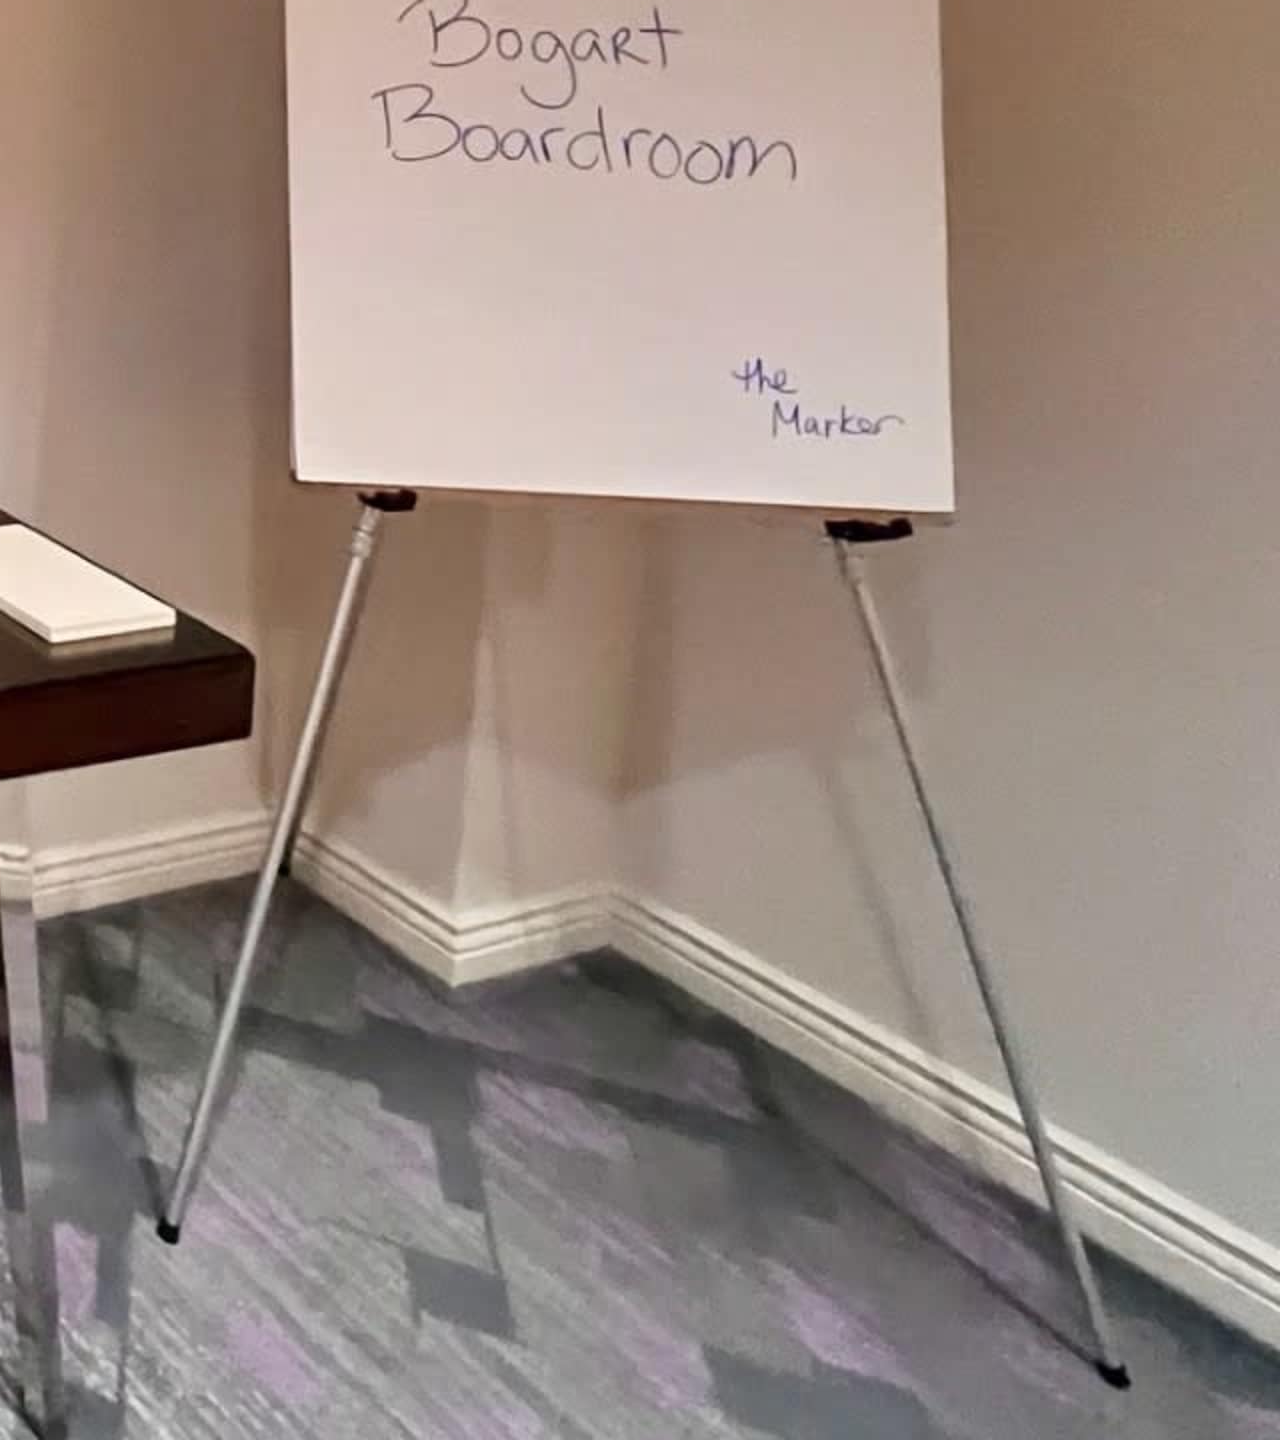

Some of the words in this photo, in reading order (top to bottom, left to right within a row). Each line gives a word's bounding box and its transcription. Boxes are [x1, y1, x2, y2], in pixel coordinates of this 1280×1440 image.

[370, 82, 798, 185] Boardroom
[730, 357, 799, 395] the
[771, 399, 905, 440] Marker
